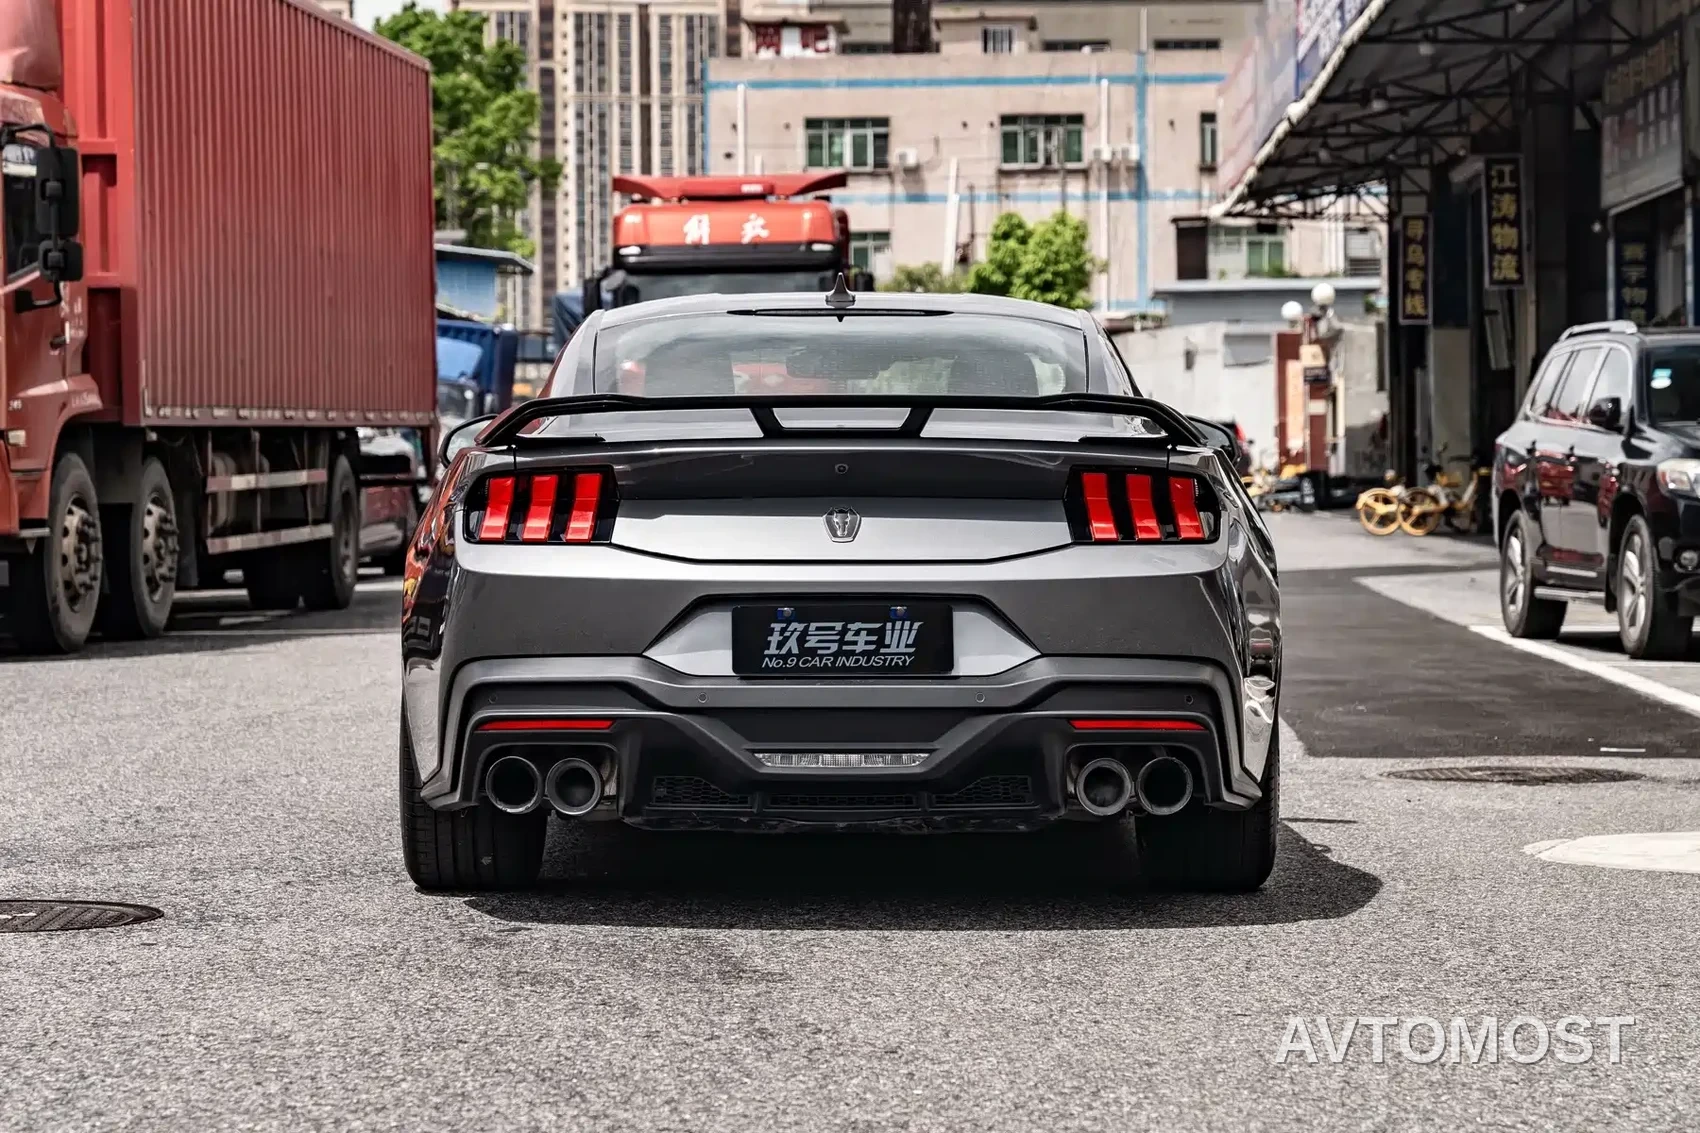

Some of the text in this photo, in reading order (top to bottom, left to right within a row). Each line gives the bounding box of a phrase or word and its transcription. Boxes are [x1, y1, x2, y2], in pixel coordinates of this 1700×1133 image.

[763, 620, 924, 655] 玖号车业
[762, 655, 915, 669] No.9 CAR INDUSTRY
